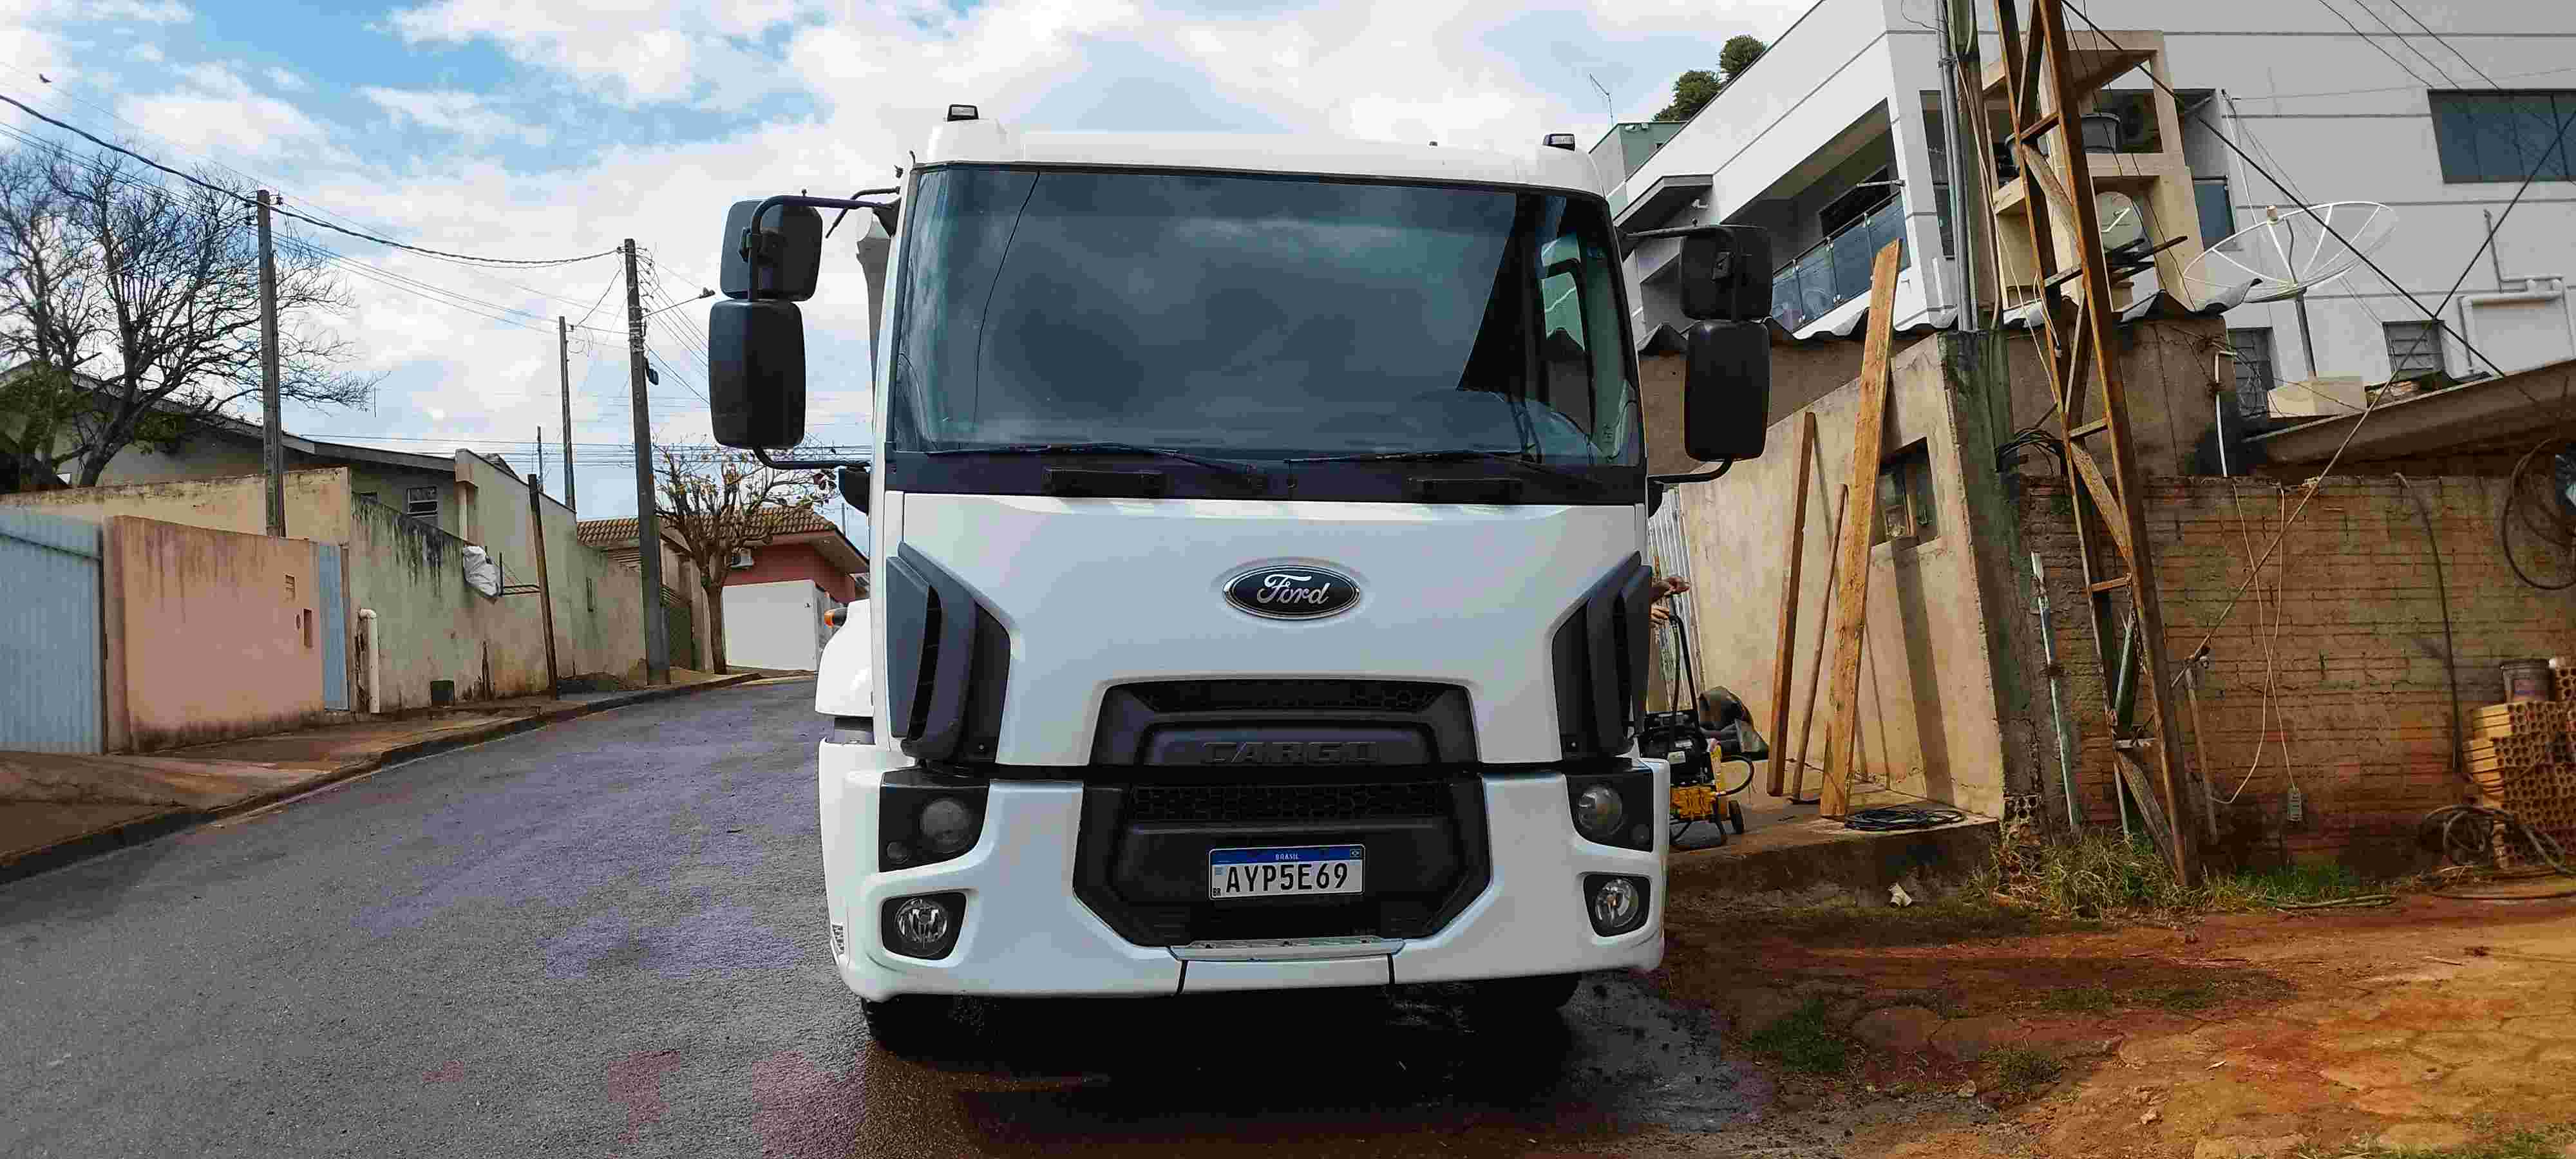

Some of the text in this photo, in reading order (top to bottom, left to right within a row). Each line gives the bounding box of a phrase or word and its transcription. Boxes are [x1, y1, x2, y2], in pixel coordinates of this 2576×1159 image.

[1256, 574, 1331, 605] Ford
[1201, 741, 1379, 765] CARGO
[1226, 863, 1348, 892] AYP5E69
[1213, 887, 1221, 896] BR
